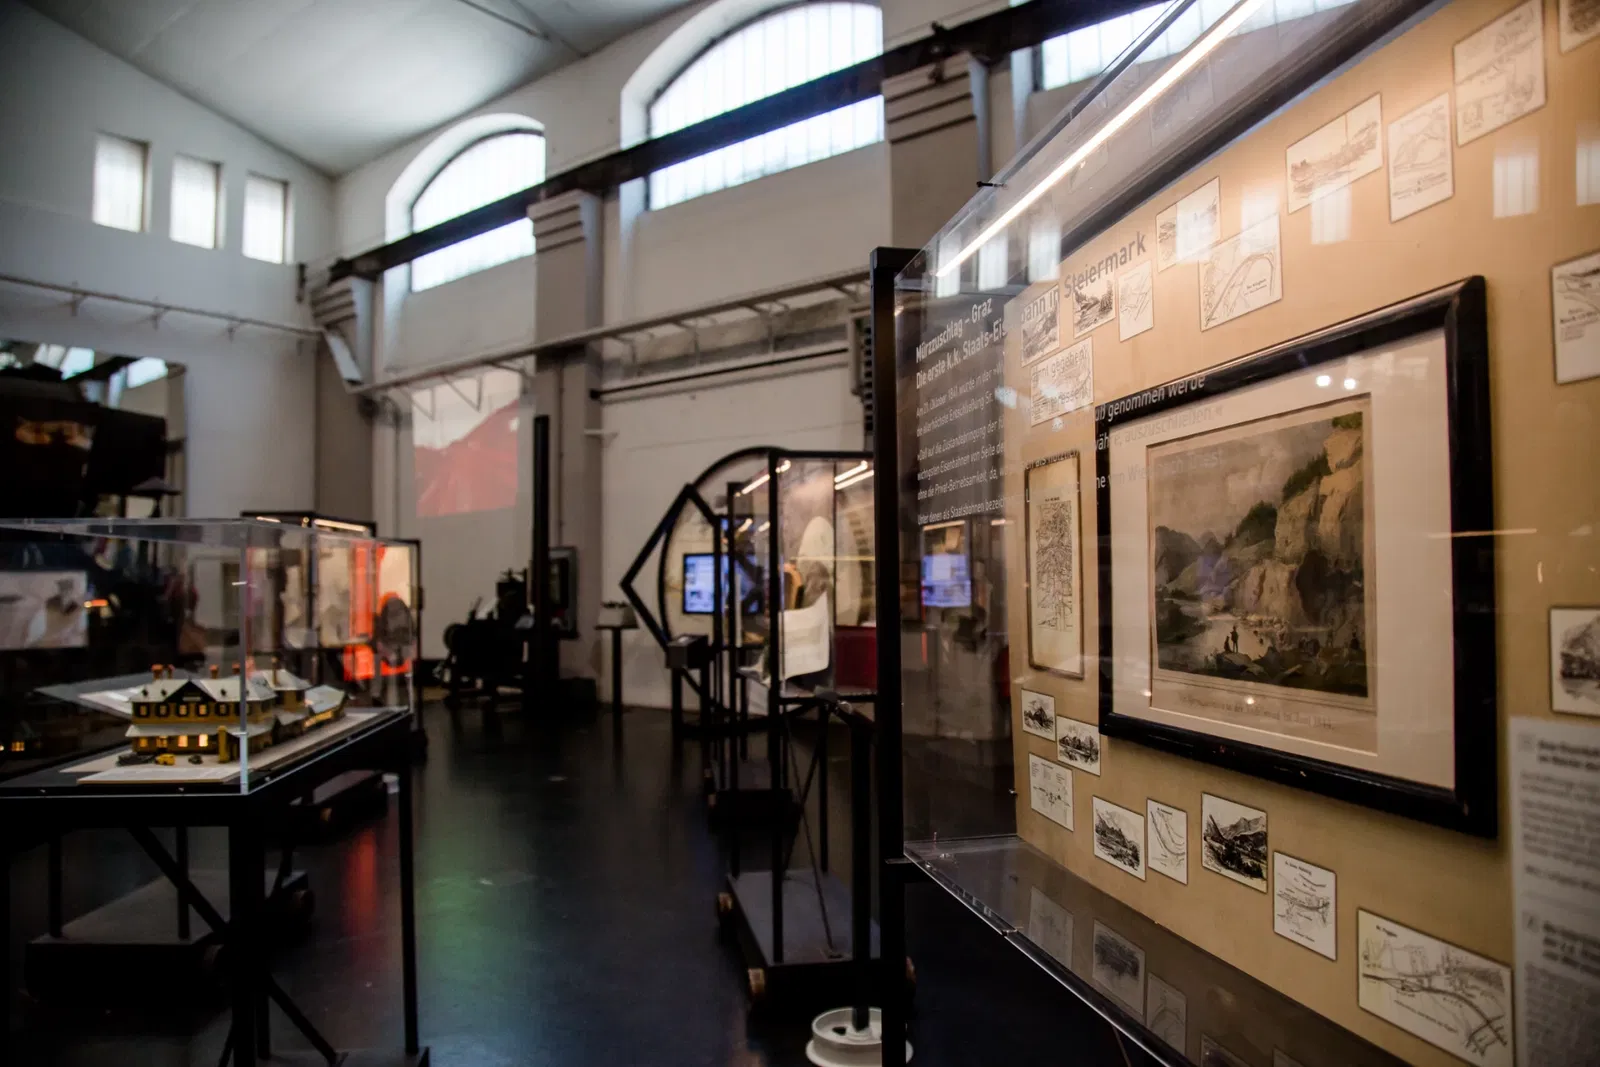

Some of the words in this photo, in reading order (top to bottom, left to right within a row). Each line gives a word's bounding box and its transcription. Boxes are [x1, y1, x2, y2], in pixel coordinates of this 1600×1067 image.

[916, 369, 927, 390] Die
[927, 358, 946, 383] erste
[947, 347, 962, 371] k.k.
[1064, 231, 1147, 299] Steiermark
[916, 318, 963, 363] Mürzzuschlag
[972, 298, 992, 324] Graz
[981, 445, 996, 459] Seite
[1107, 384, 1165, 422] genommen
[987, 419, 998, 434] der
